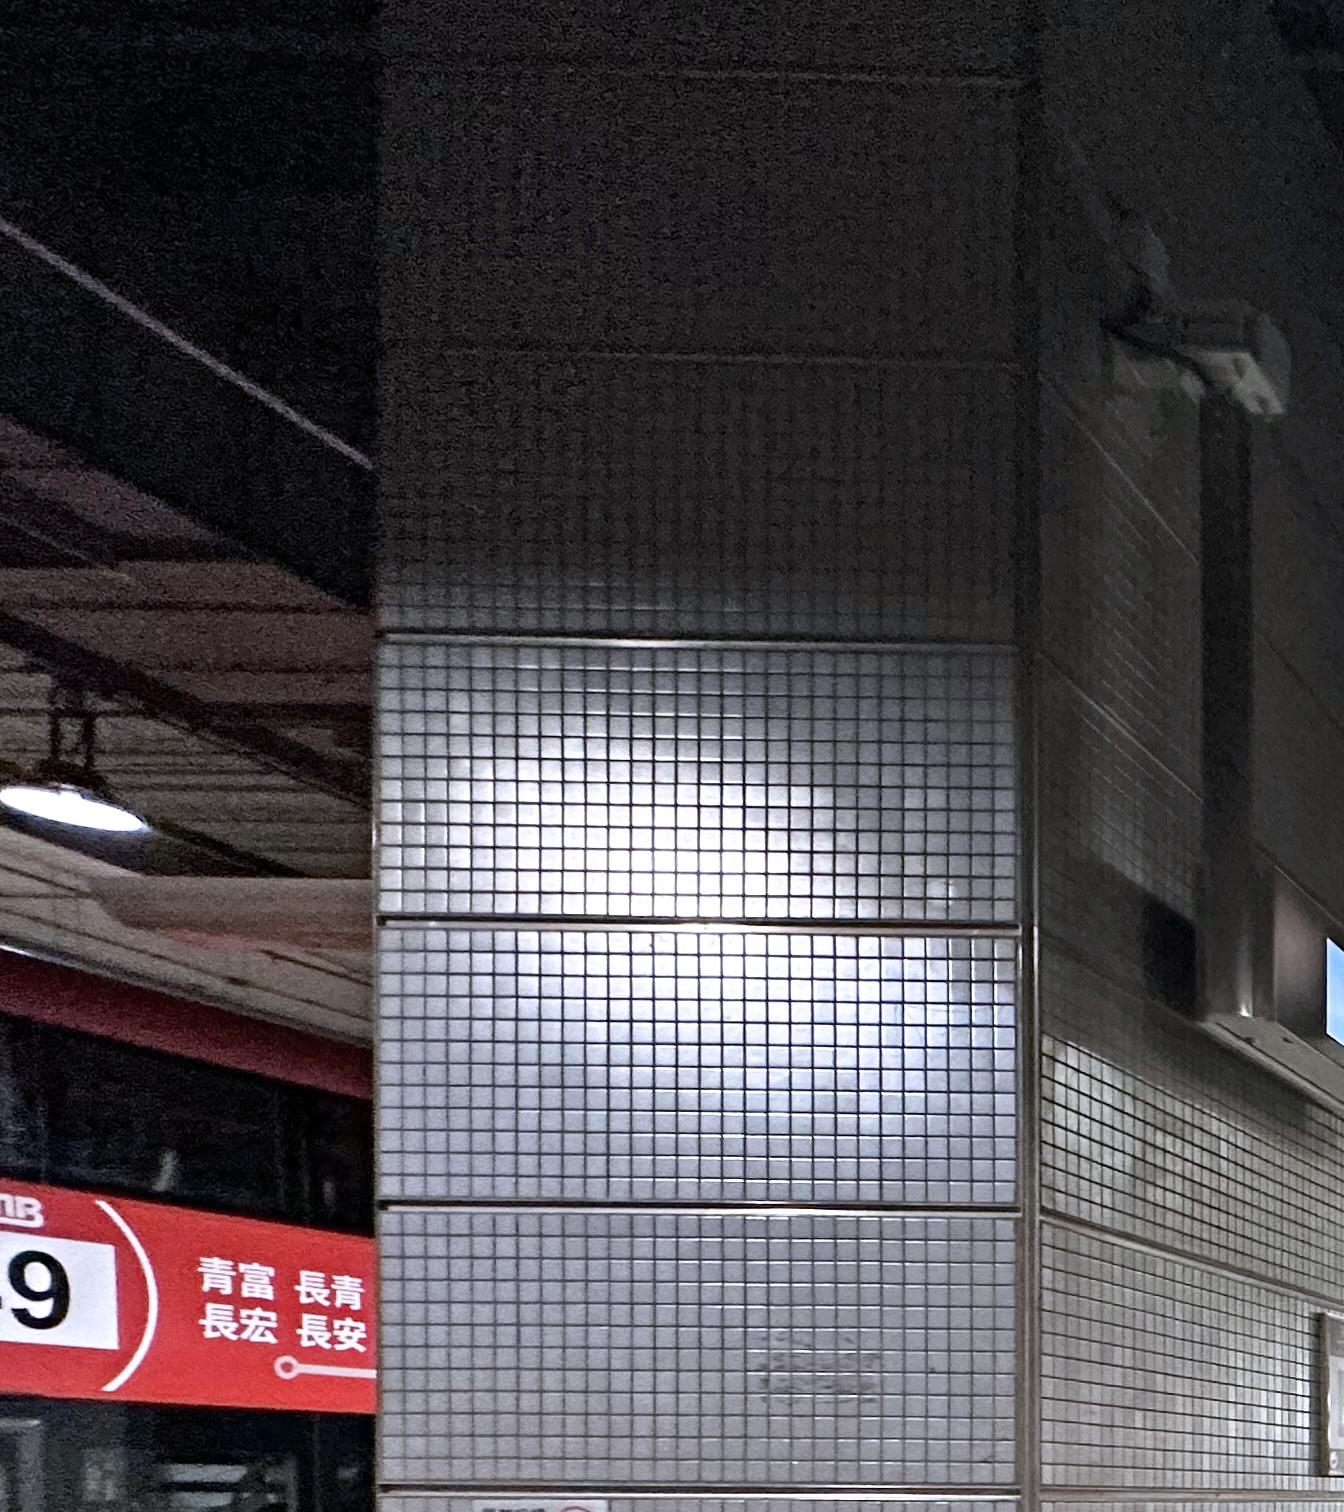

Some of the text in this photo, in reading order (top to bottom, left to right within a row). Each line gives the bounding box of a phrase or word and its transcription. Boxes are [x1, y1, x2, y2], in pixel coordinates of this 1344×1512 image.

[0, 1250, 70, 1330] 9
[197, 1256, 365, 1312] 青富 長青
[199, 1303, 368, 1352] 長宏 長安
